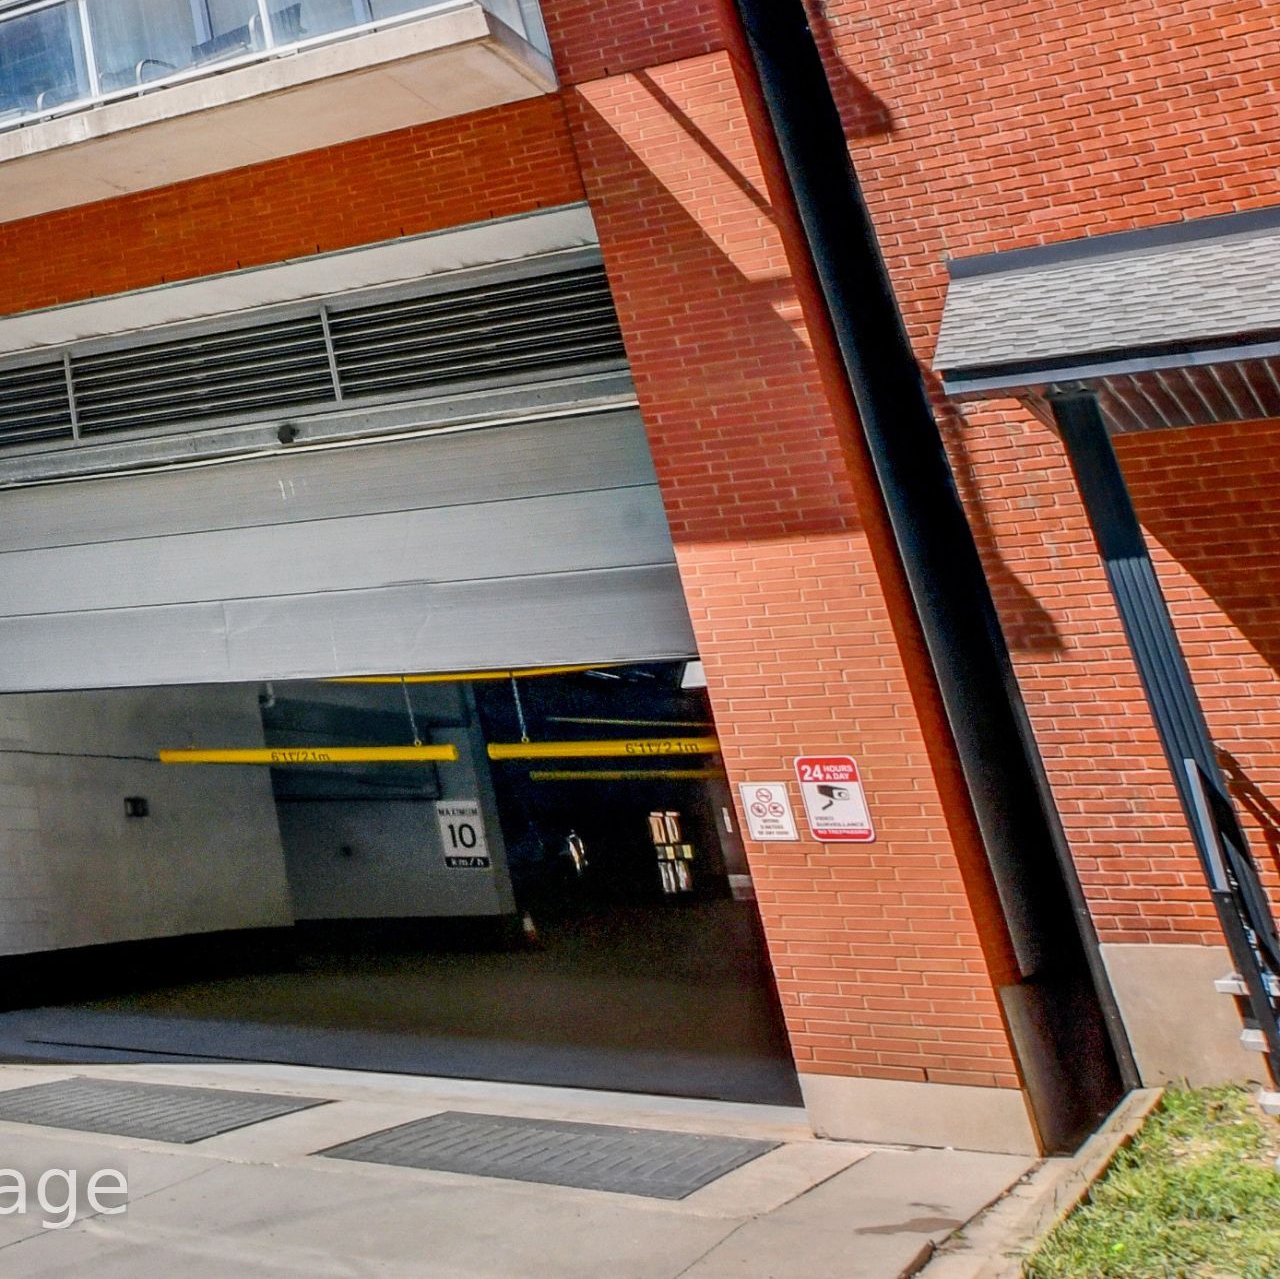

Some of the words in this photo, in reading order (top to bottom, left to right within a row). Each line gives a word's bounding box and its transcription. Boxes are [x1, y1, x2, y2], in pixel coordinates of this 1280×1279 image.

[801, 764, 824, 781] 24
[823, 764, 853, 773] HOURS
[825, 772, 834, 781] A
[833, 772, 850, 781] DAY
[448, 823, 477, 848] 10
